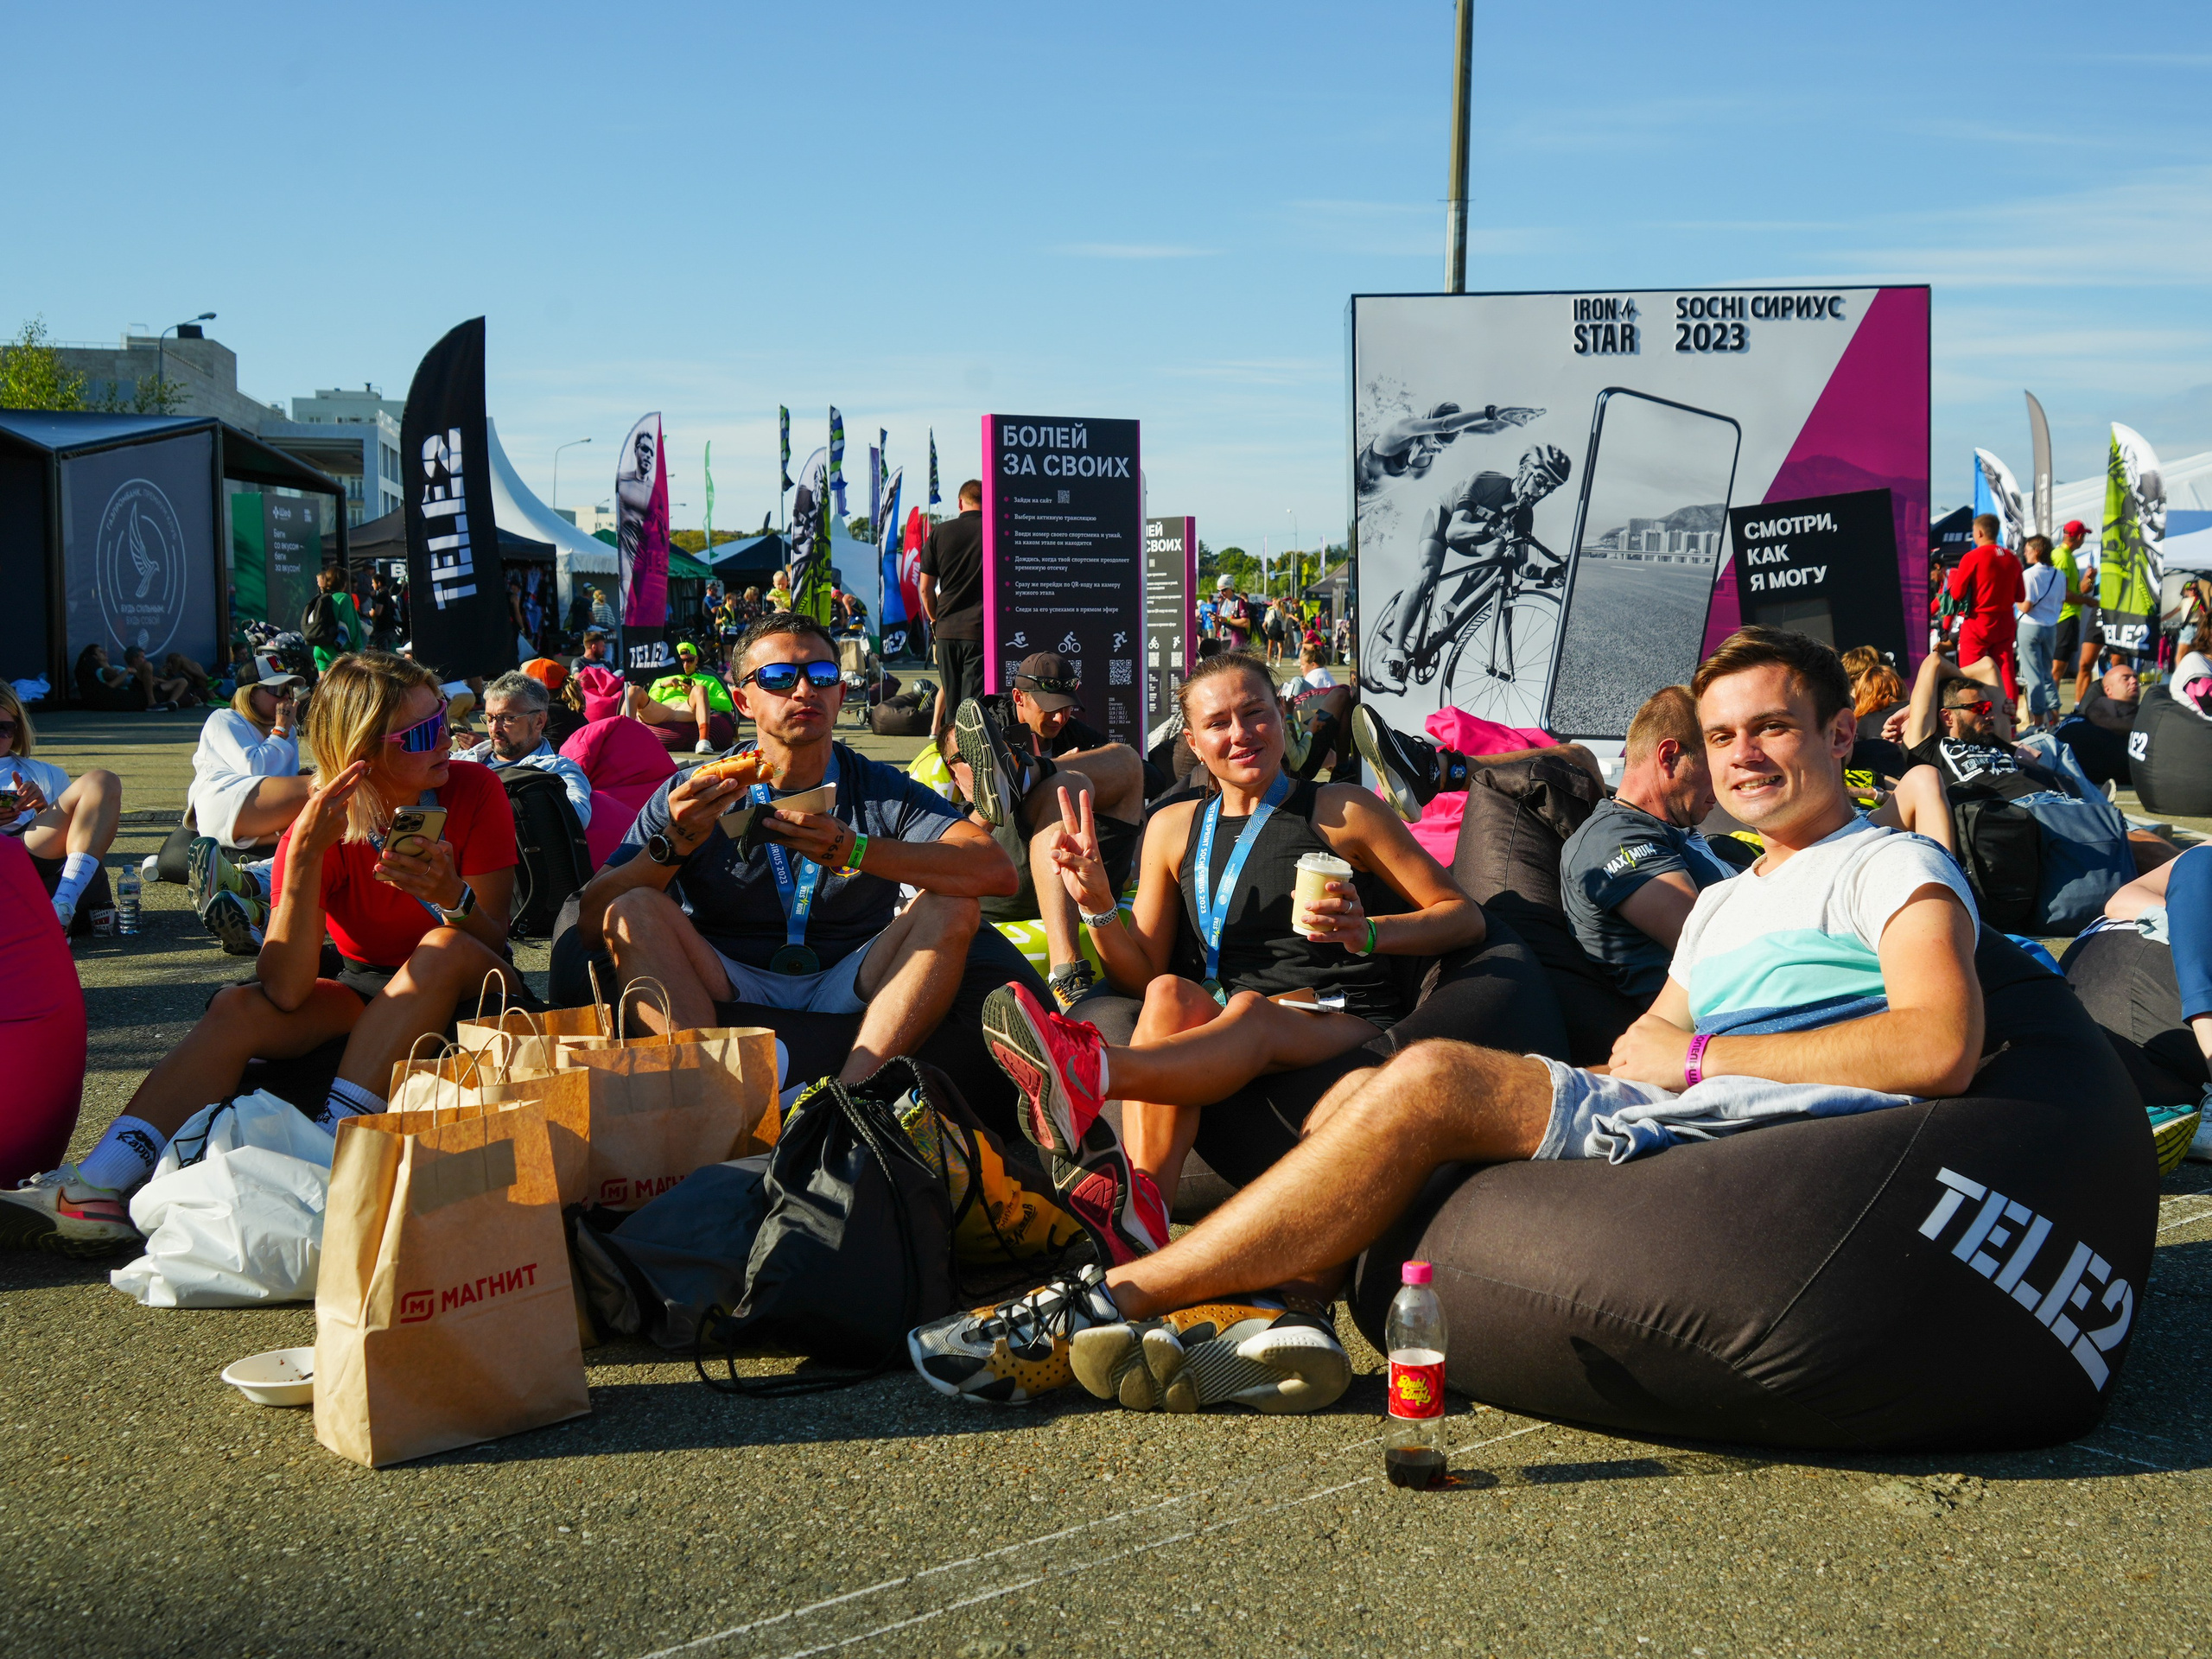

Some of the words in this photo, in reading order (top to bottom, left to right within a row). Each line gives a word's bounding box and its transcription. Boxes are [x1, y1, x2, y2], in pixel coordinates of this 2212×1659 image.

[1573, 298, 1617, 321] IRON
[1675, 296, 1744, 319] SOCHI
[1751, 296, 1841, 318] СИРИУС
[1574, 323, 1636, 353] STAR
[1675, 322, 1745, 351] 2023
[1003, 423, 1087, 448] БОЛЕЙ
[1003, 453, 1037, 475] ЗА
[1043, 454, 1130, 478] СВОИХ
[421, 427, 477, 610] TELE2
[1744, 512, 1838, 540] СМОТРИ,
[1747, 544, 1789, 566] КАК
[1750, 573, 1765, 592] Я
[1769, 565, 1827, 589] МОГУ
[629, 640, 677, 669] TELE2
[1198, 848, 1208, 869] SOCHI
[776, 865, 788, 885] 2023
[1198, 869, 1206, 894] SIRIUS
[798, 885, 809, 899] STAR
[795, 902, 804, 915] IRON
[442, 1262, 537, 1313] МАГНИТ
[1917, 1166, 2133, 1393] TELE2
[1397, 1374, 1427, 1390] Dubl
[1400, 1387, 1432, 1407] Bubl
